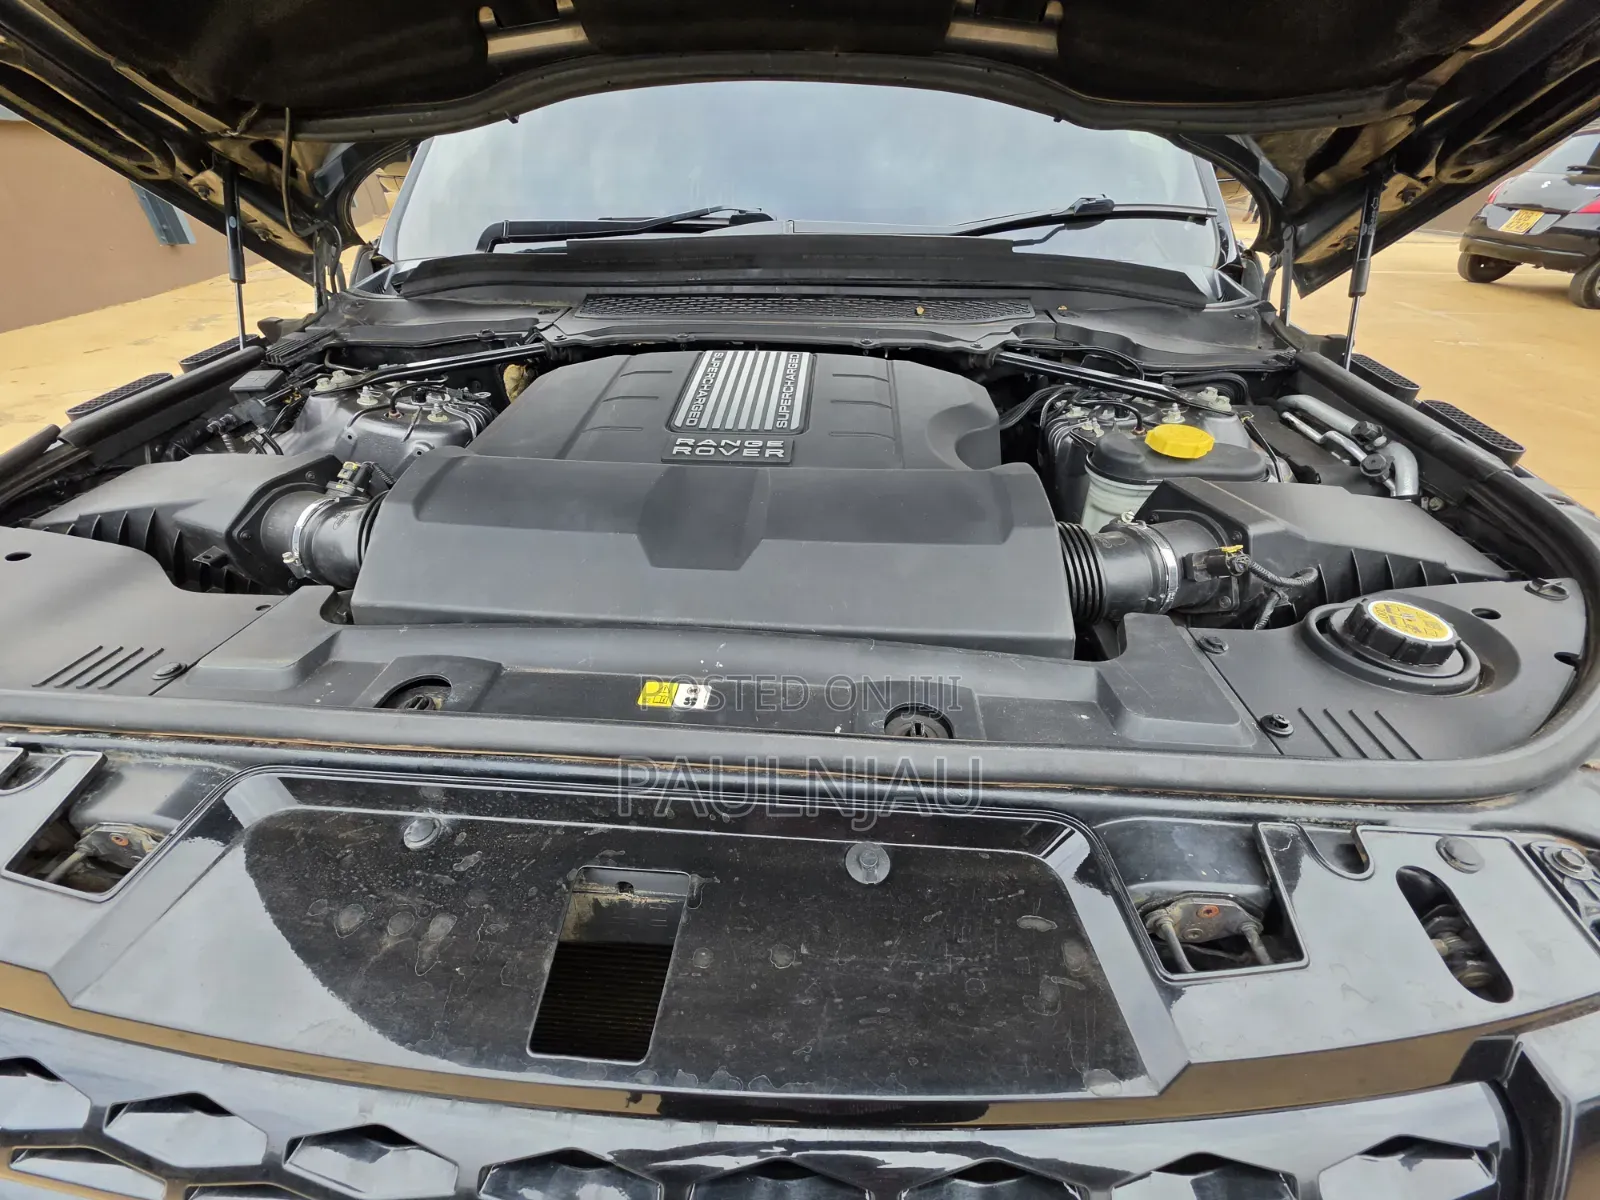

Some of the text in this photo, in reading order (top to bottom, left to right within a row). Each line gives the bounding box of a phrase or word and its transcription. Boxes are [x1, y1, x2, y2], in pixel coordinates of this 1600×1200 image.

[686, 352, 724, 427] SUPERCHARGED
[776, 353, 800, 429] SUPERCHARGED
[672, 446, 785, 458] ROVER
[675, 438, 784, 447] RANGE
